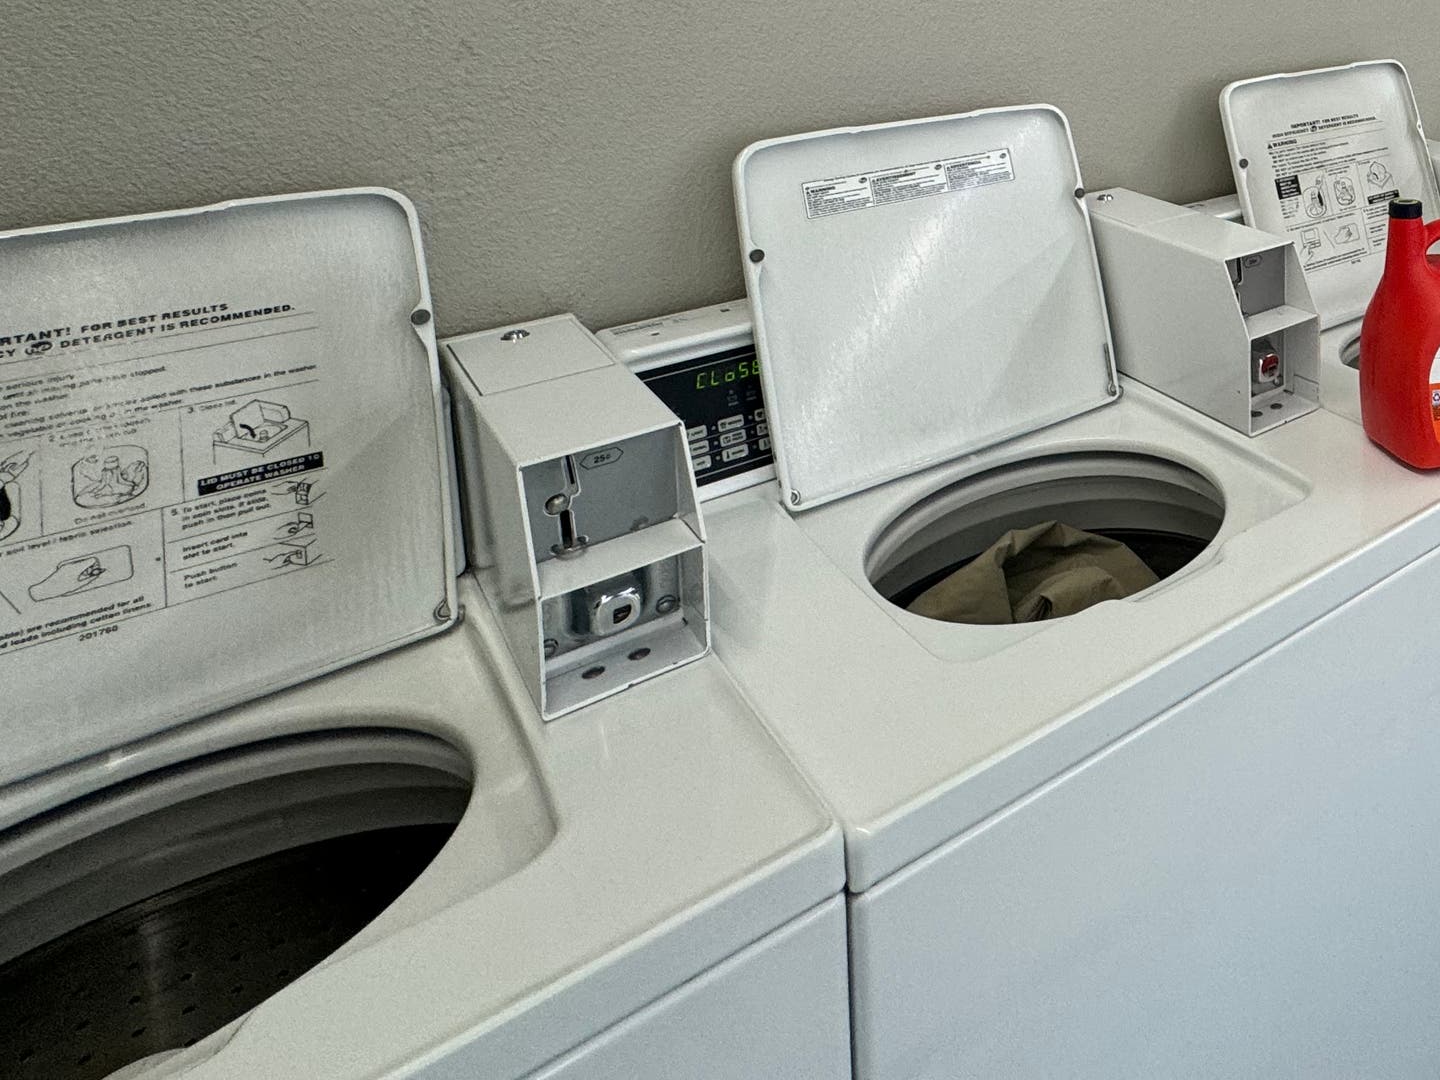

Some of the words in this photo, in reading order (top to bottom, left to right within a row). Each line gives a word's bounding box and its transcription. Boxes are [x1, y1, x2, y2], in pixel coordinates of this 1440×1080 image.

[60, 326, 156, 349] DETERGENT
[161, 322, 176, 332] IS
[180, 304, 296, 329] RECOMMENDED.
[81, 322, 113, 334] FOR
[117, 315, 157, 328] BEST
[162, 303, 230, 321] RESULTS
[200, 477, 218, 487] LID
[220, 469, 249, 483] MUST
[267, 456, 306, 471] CLOSED
[216, 474, 262, 491] OPERATE
[264, 464, 306, 479] WASHER
[182, 541, 208, 552] Insert
[184, 570, 207, 581] Push
[209, 562, 238, 574] button
[27, 624, 43, 633] are
[45, 603, 115, 628] recommended
[41, 620, 87, 637] including
[90, 611, 121, 624] cotton
